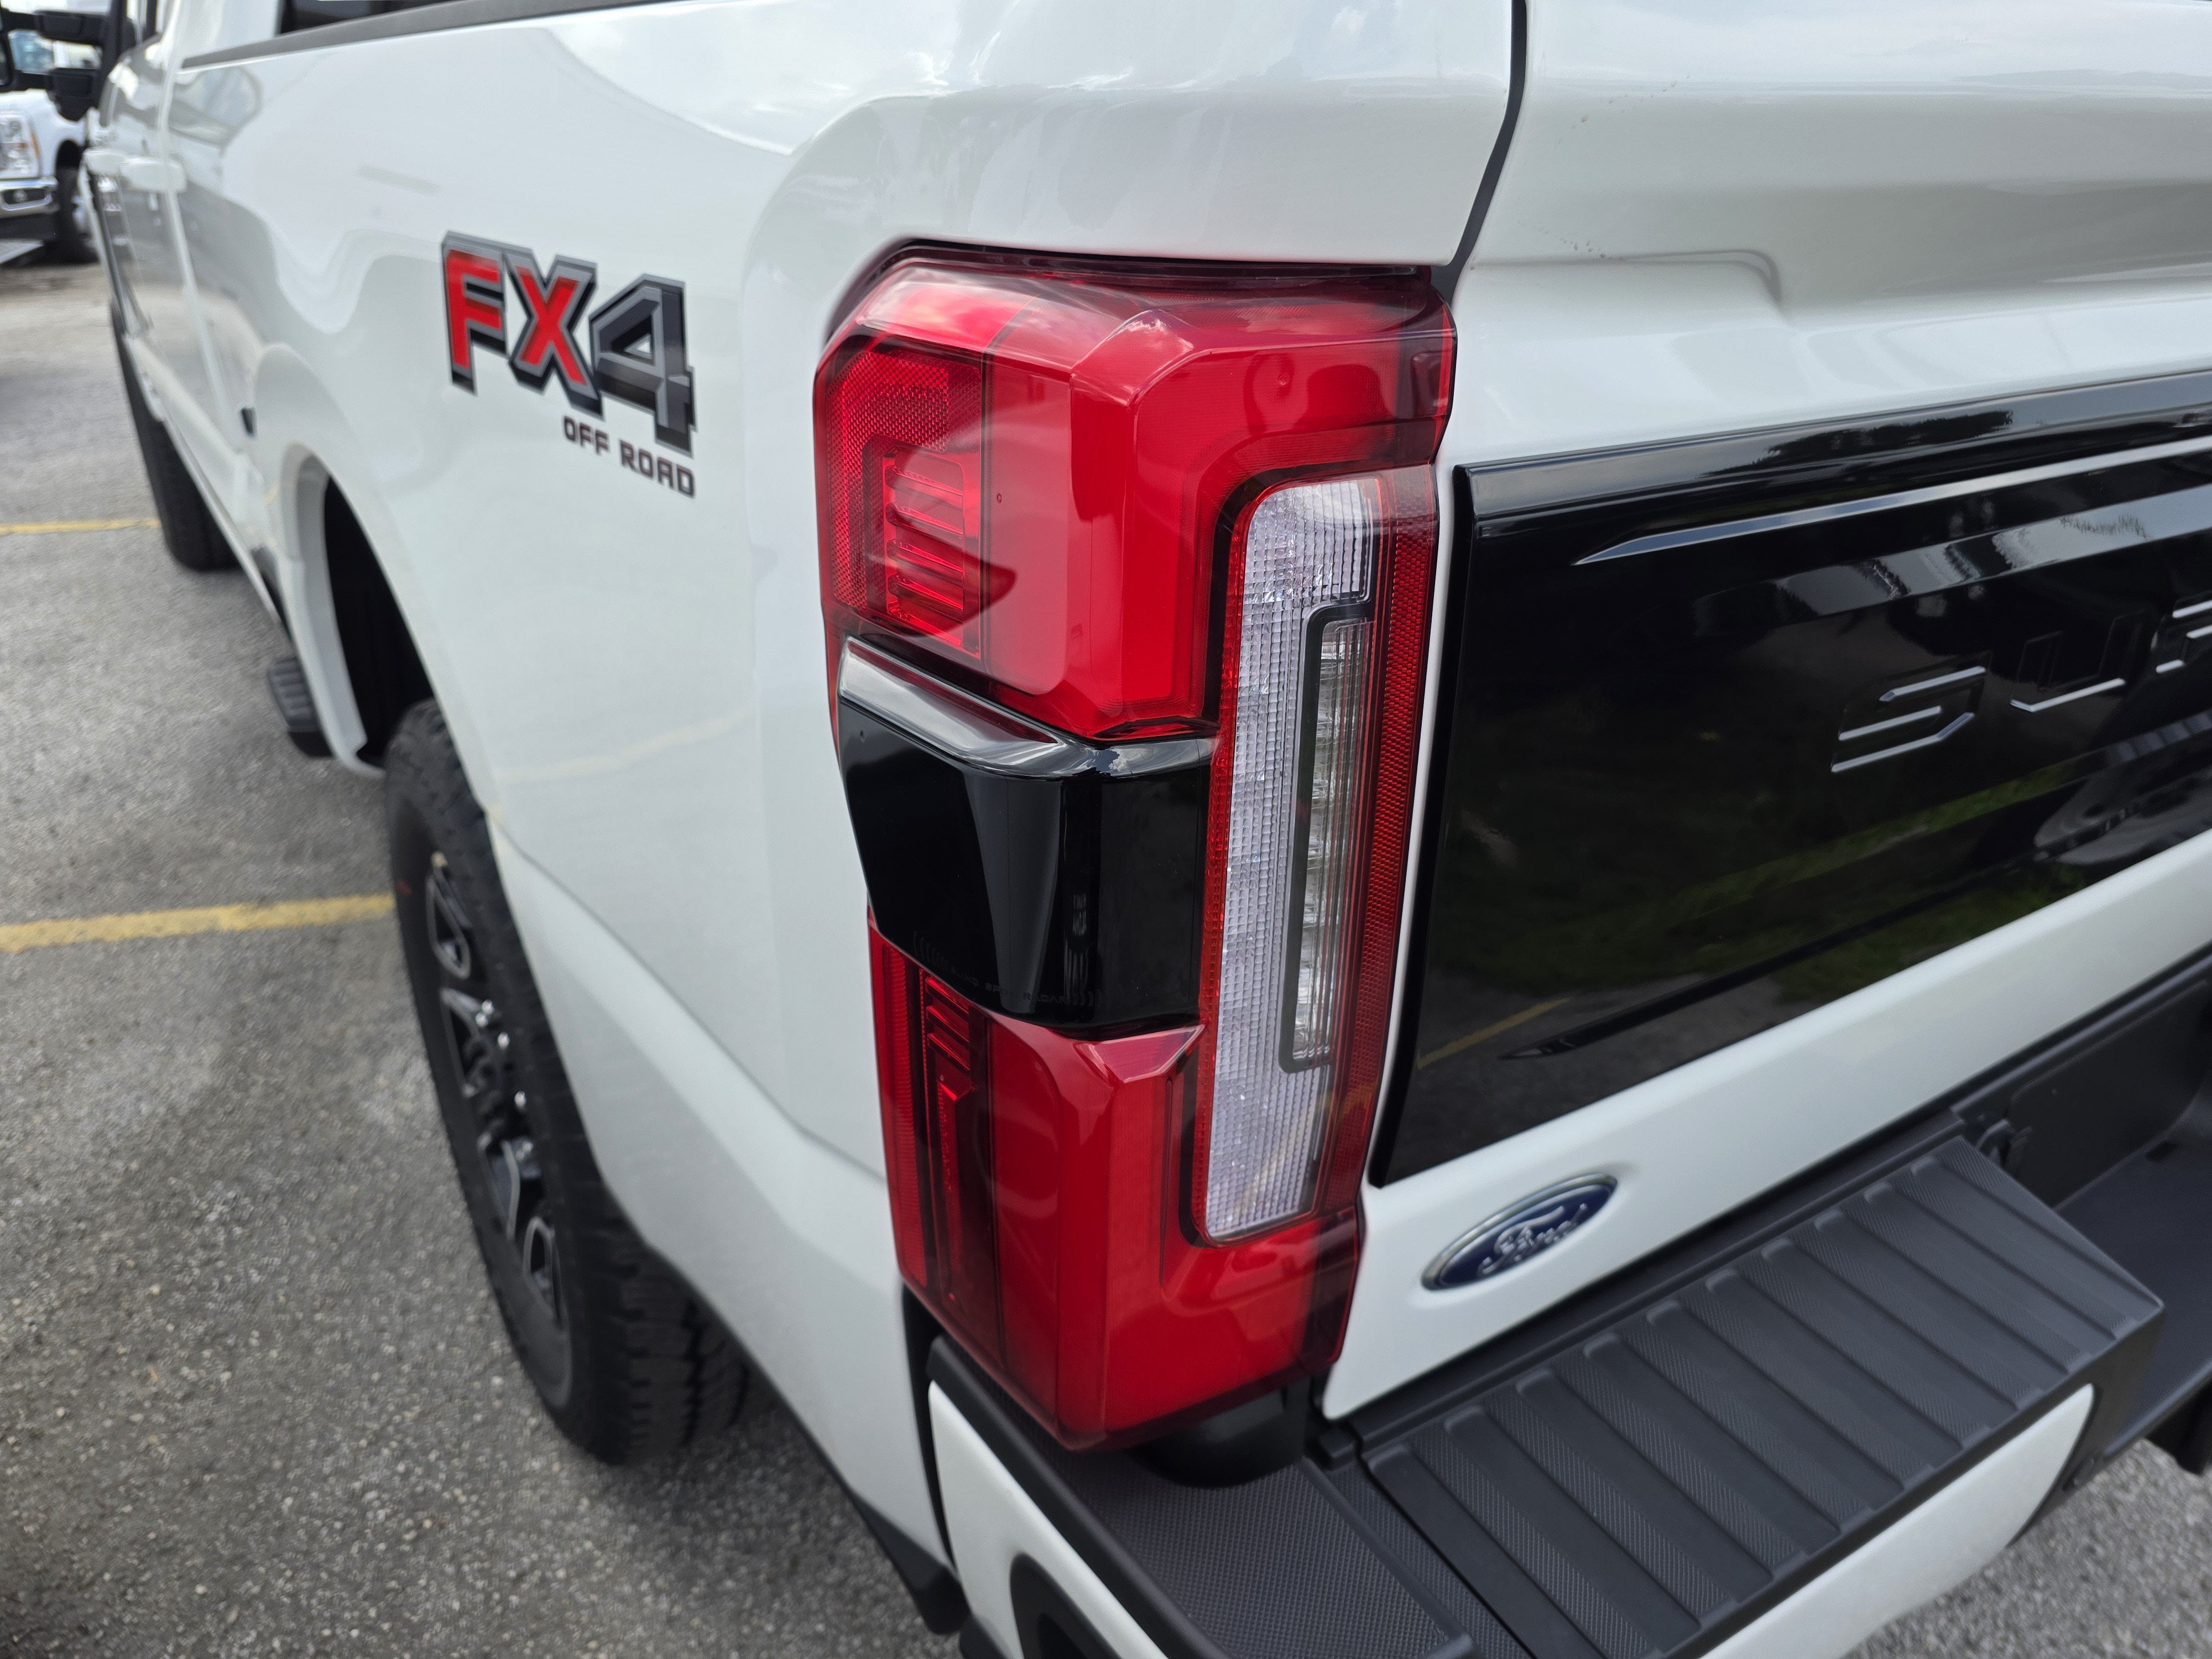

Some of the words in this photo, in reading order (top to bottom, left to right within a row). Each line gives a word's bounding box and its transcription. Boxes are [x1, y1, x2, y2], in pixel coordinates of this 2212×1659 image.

[441, 231, 696, 458] FX4
[564, 415, 610, 455] OFF
[619, 440, 695, 499] ROAD
